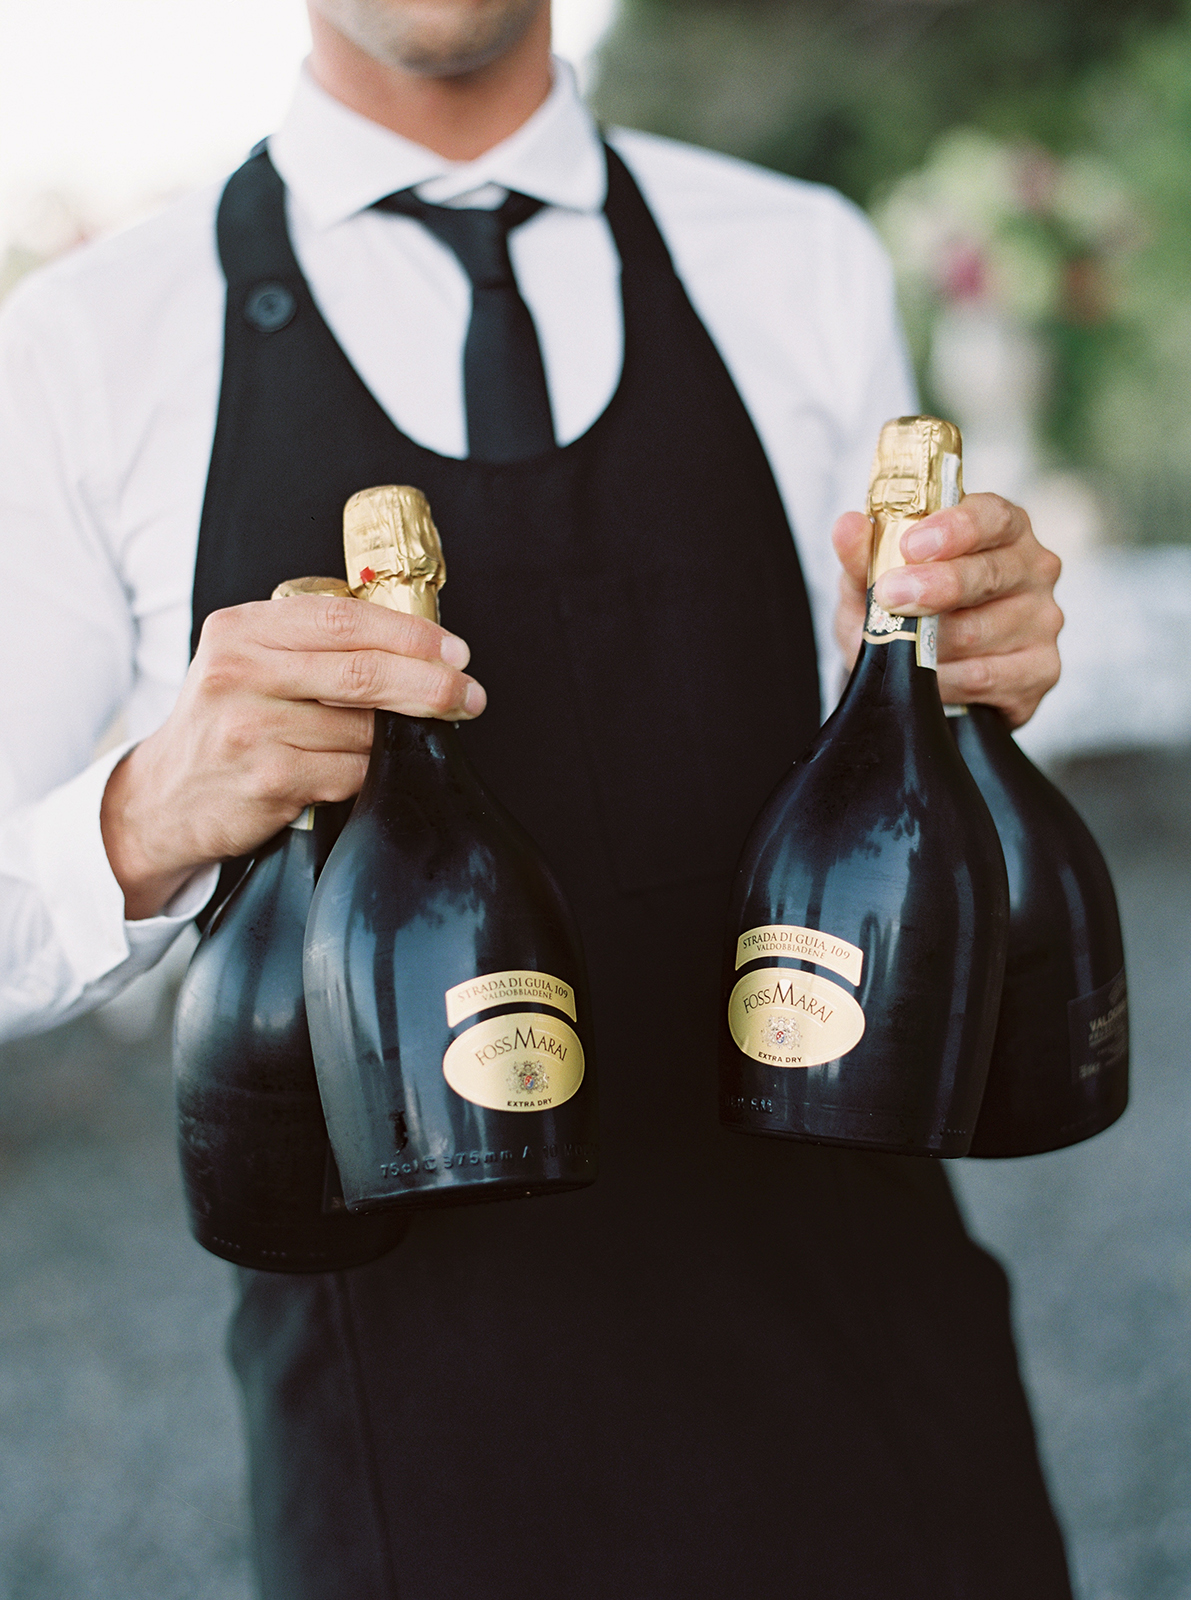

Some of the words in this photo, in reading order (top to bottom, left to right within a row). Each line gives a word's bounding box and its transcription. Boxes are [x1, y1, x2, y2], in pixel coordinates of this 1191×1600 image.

[743, 932, 777, 949] STRADA
[780, 932, 792, 942] DI
[831, 945, 850, 960] 109
[757, 943, 824, 959] VALDOBBIADENE
[457, 980, 506, 1002] STRADA
[509, 978, 522, 988] DI
[555, 985, 568, 998] 109
[482, 989, 552, 1001] VALDOBBIADENE
[758, 1051, 782, 1062] EXTRA
[537, 1098, 552, 1106] DRY
